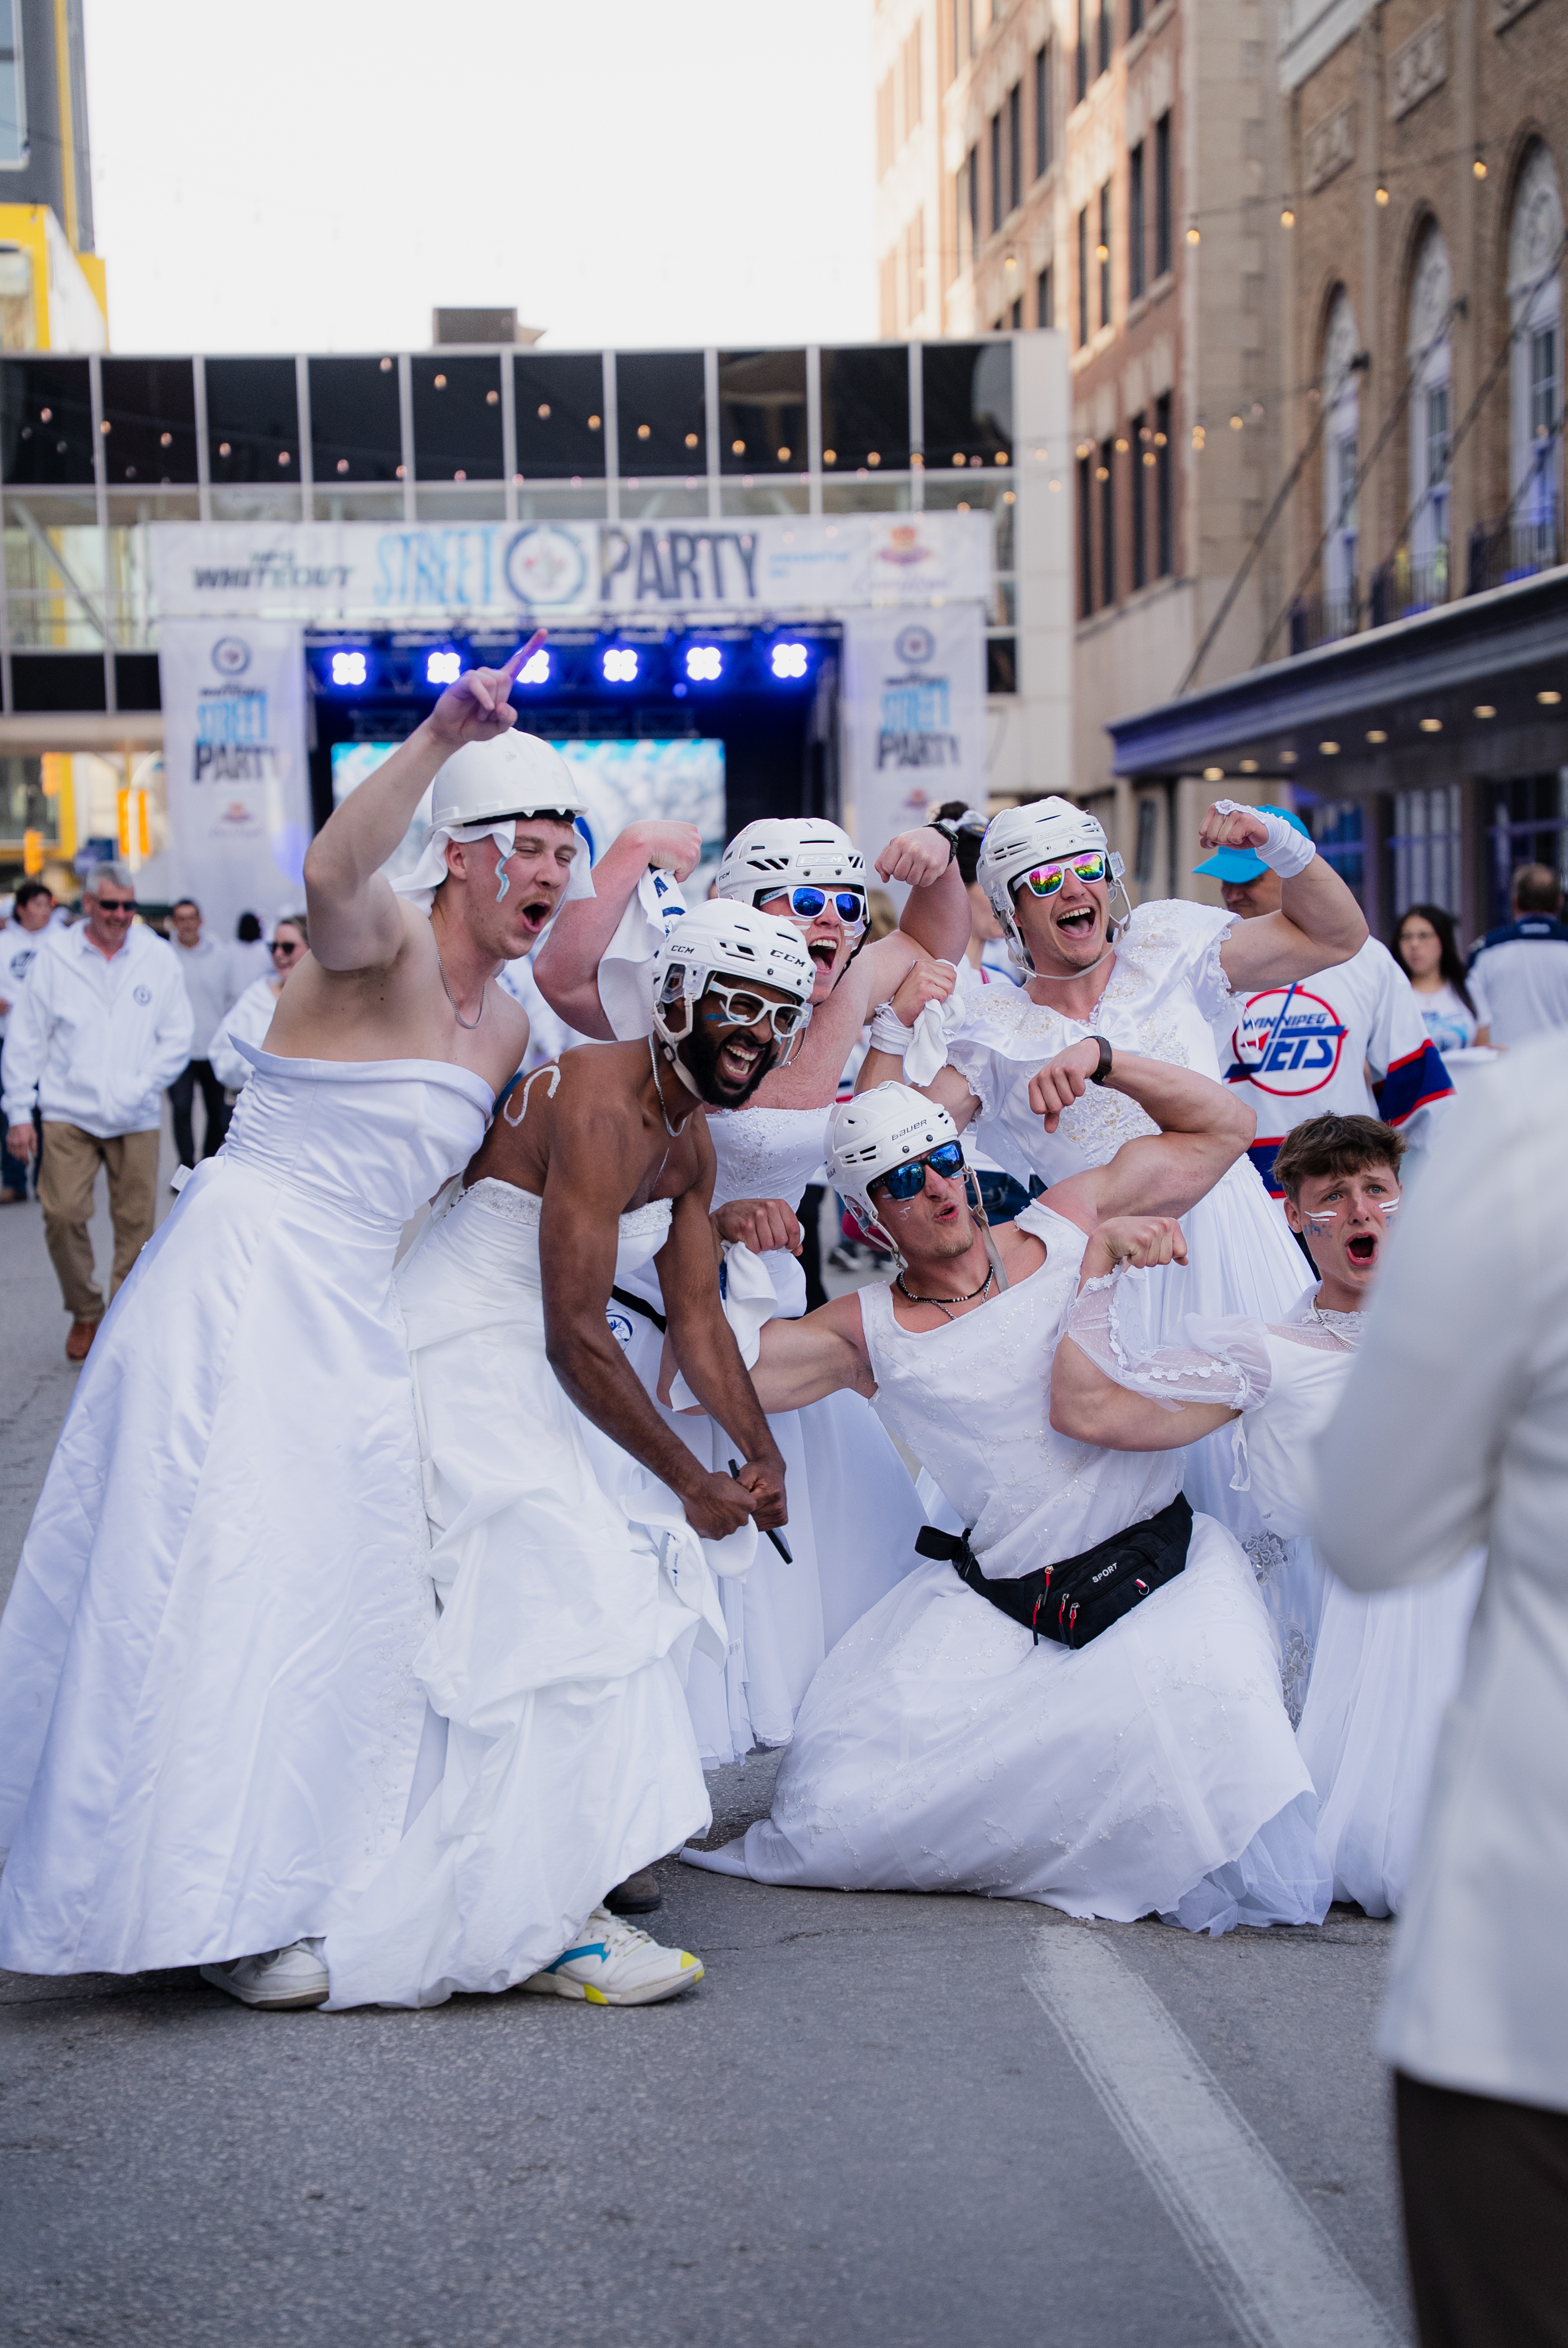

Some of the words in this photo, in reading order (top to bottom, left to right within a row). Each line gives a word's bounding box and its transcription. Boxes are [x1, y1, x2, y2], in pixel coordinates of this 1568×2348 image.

[600, 529, 758, 599] PARTY
[800, 856, 842, 864] CCM
[671, 945, 695, 954] CCM
[770, 949, 806, 968] CCM
[1242, 1013, 1328, 1031] WINNIPEG
[1223, 1024, 1346, 1079] JETS
[1092, 1562, 1117, 1583] SPORT
